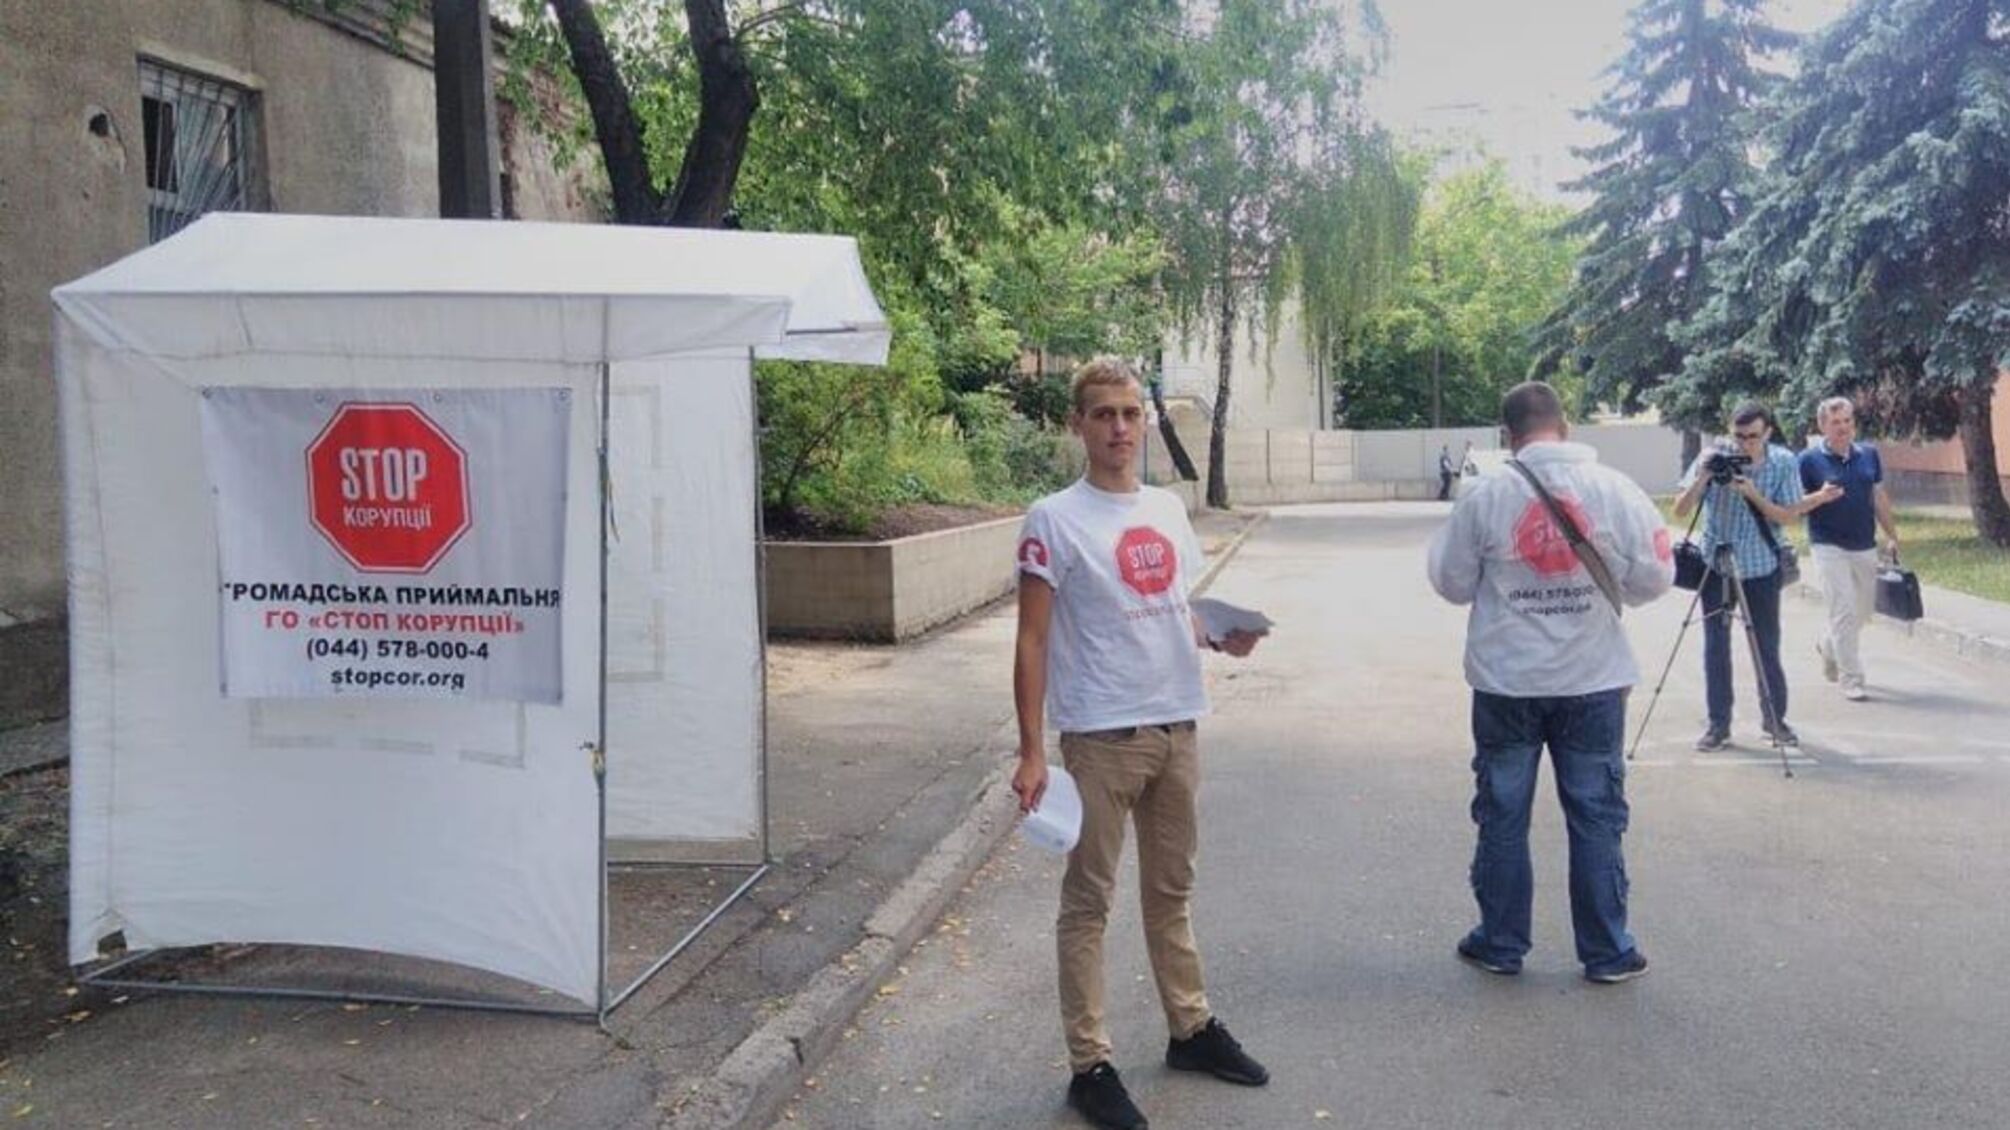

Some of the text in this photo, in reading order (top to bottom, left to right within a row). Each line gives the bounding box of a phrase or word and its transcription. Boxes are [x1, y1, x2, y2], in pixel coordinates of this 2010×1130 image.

[340, 447, 427, 501] STOP
[343, 503, 432, 531] КОРУПЦІЇ
[1127, 543, 1165, 569] STOP
[224, 582, 388, 605] РОМАДСЬКА
[266, 610, 525, 635] ГО «СТОП КОРУПЦІЇ»
[307, 638, 489, 661] (044) 578-000-4
[331, 667, 465, 690] stopcor.org
